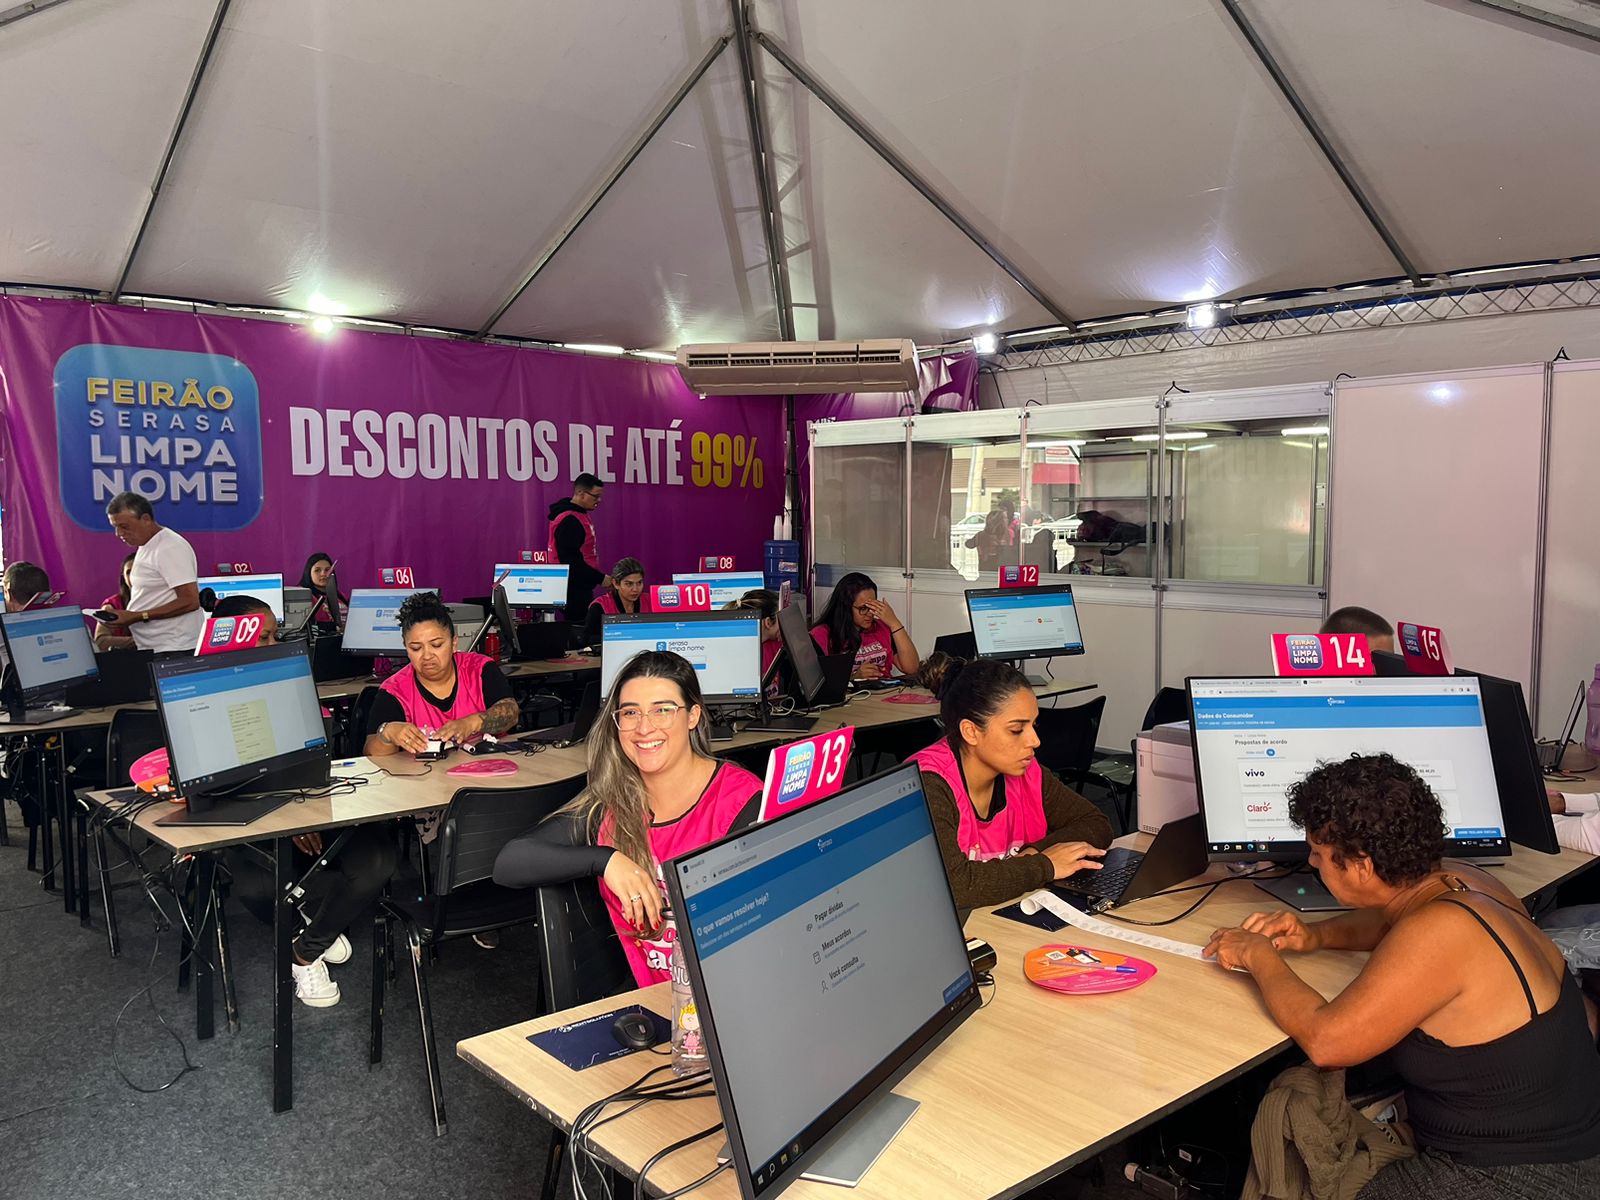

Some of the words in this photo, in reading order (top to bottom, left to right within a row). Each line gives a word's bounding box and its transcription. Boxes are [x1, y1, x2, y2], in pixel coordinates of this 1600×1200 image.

[87, 377, 233, 410] FEIRÃO
[88, 409, 235, 432] SERASA
[90, 435, 237, 467] LIMPA
[289, 406, 559, 482] DESCONTOS
[569, 423, 616, 482] DE
[624, 419, 684, 486] ATÉ
[690, 431, 764, 489] 99%
[92, 468, 239, 502] NOME
[533, 551, 545, 562] 04
[720, 557, 732, 569] 08
[234, 563, 250, 573] 02
[396, 569, 410, 584] 06
[1023, 566, 1036, 582] 12
[685, 585, 706, 606] 10
[236, 616, 260, 643] 09
[1330, 636, 1365, 668] 14
[1421, 629, 1440, 661] 15
[816, 735, 846, 788] 13
[785, 768, 808, 783] LIMPA
[1245, 769, 1265, 777] vivo
[782, 778, 806, 795] NOME
[1247, 802, 1270, 812] Claro
[714, 912, 734, 928] vamos
